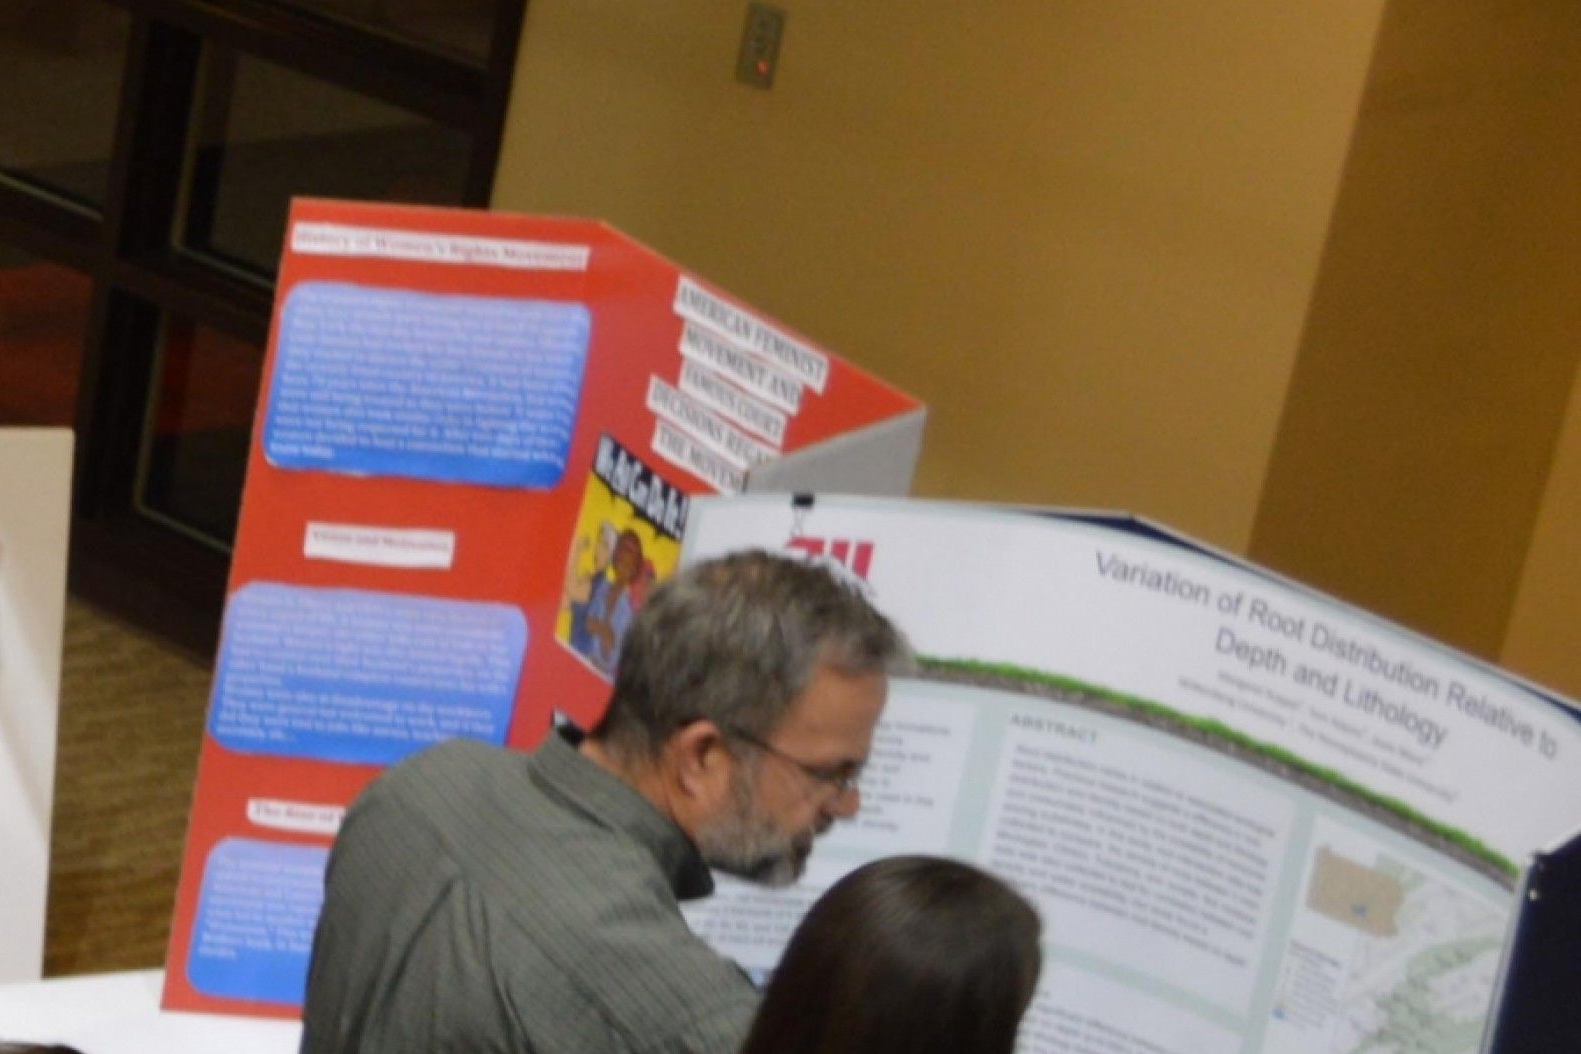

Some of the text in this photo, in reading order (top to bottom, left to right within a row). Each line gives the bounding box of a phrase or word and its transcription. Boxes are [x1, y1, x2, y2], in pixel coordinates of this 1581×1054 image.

[686, 324, 769, 391] MOVEMENT
[754, 325, 827, 380] FEMINIST
[1096, 549, 1211, 605] Variation
[1217, 590, 1244, 616] of
[1248, 597, 1306, 642] Root
[1309, 621, 1440, 699] Distribution
[1445, 679, 1535, 745] Relative
[1538, 728, 1558, 759] to
[1215, 625, 1287, 675] Depth
[1293, 661, 1339, 698] and
[1343, 678, 1448, 751] Lithology
